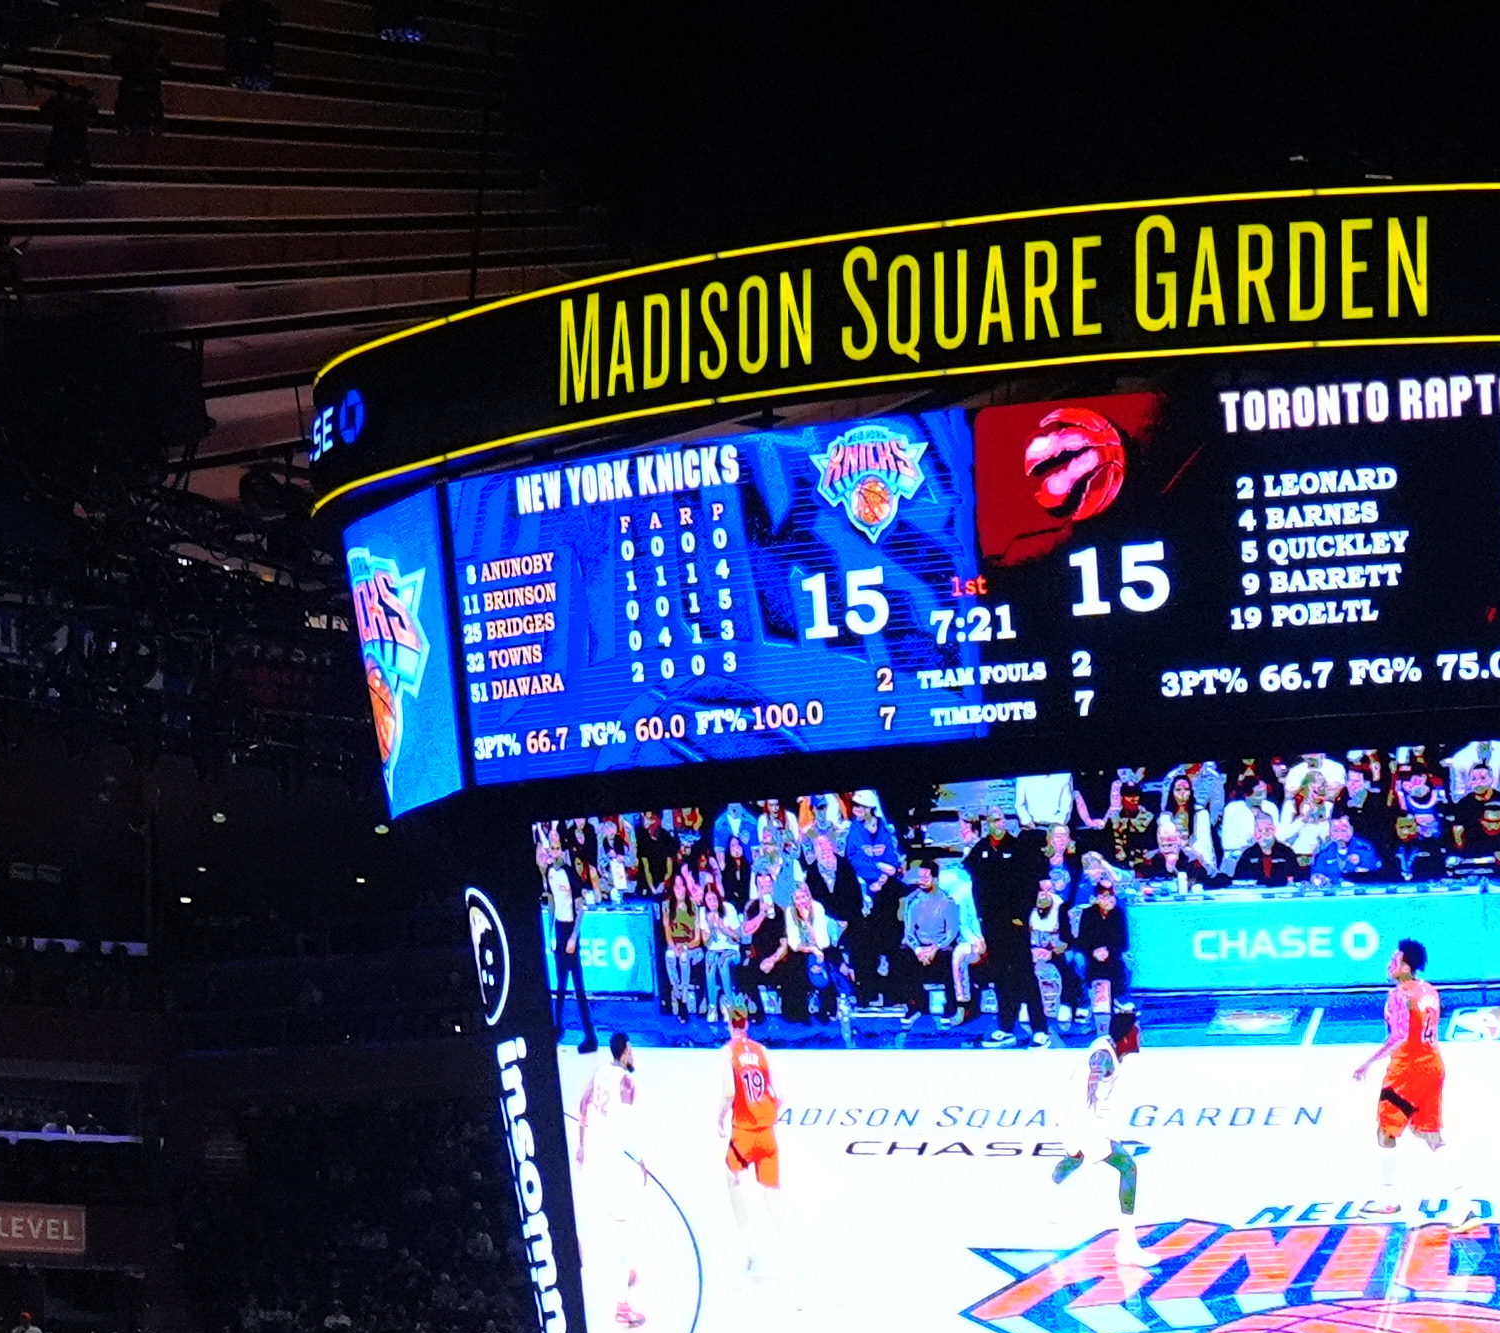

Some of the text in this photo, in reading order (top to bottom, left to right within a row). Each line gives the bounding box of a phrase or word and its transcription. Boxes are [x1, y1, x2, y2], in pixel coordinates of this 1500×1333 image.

[558, 213, 1429, 406] MADISON SQUARE GARDEN
[1219, 381, 1390, 434] TORONTO
[516, 444, 741, 515] NEW YORK KNICKS
[1263, 466, 1398, 498] LEONARD
[1265, 500, 1379, 531] BARNES
[1267, 530, 1409, 565] QUICKLEY
[480, 553, 555, 583] ANUNOBY
[1068, 541, 1171, 617] 15
[1269, 562, 1402, 595] BARRETT
[463, 583, 557, 616] 11 BRUNSON
[801, 565, 890, 640] 15
[950, 574, 988, 598] 1st
[463, 612, 556, 645] 25 BRIDGES
[929, 604, 1017, 645] 7:21
[1230, 599, 1380, 631] 19 POELTL
[466, 644, 543, 673] 32 TOWNS
[470, 672, 564, 703] 51 DIAWARA
[917, 662, 1047, 690] TEAM FOULS
[1161, 666, 1248, 698] 3PT%
[1259, 660, 1334, 692] 66.7
[1348, 655, 1422, 686] FG%
[473, 700, 824, 761] 3PT% 66.7 FG% 60.0 FT% 100.0
[930, 701, 1037, 727] TIMEOUTS
[1192, 927, 1334, 961] CHASE
[776, 1103, 1324, 1130] ADISON SQUA GARDEN
[844, 1139, 1072, 1160] CHASE
